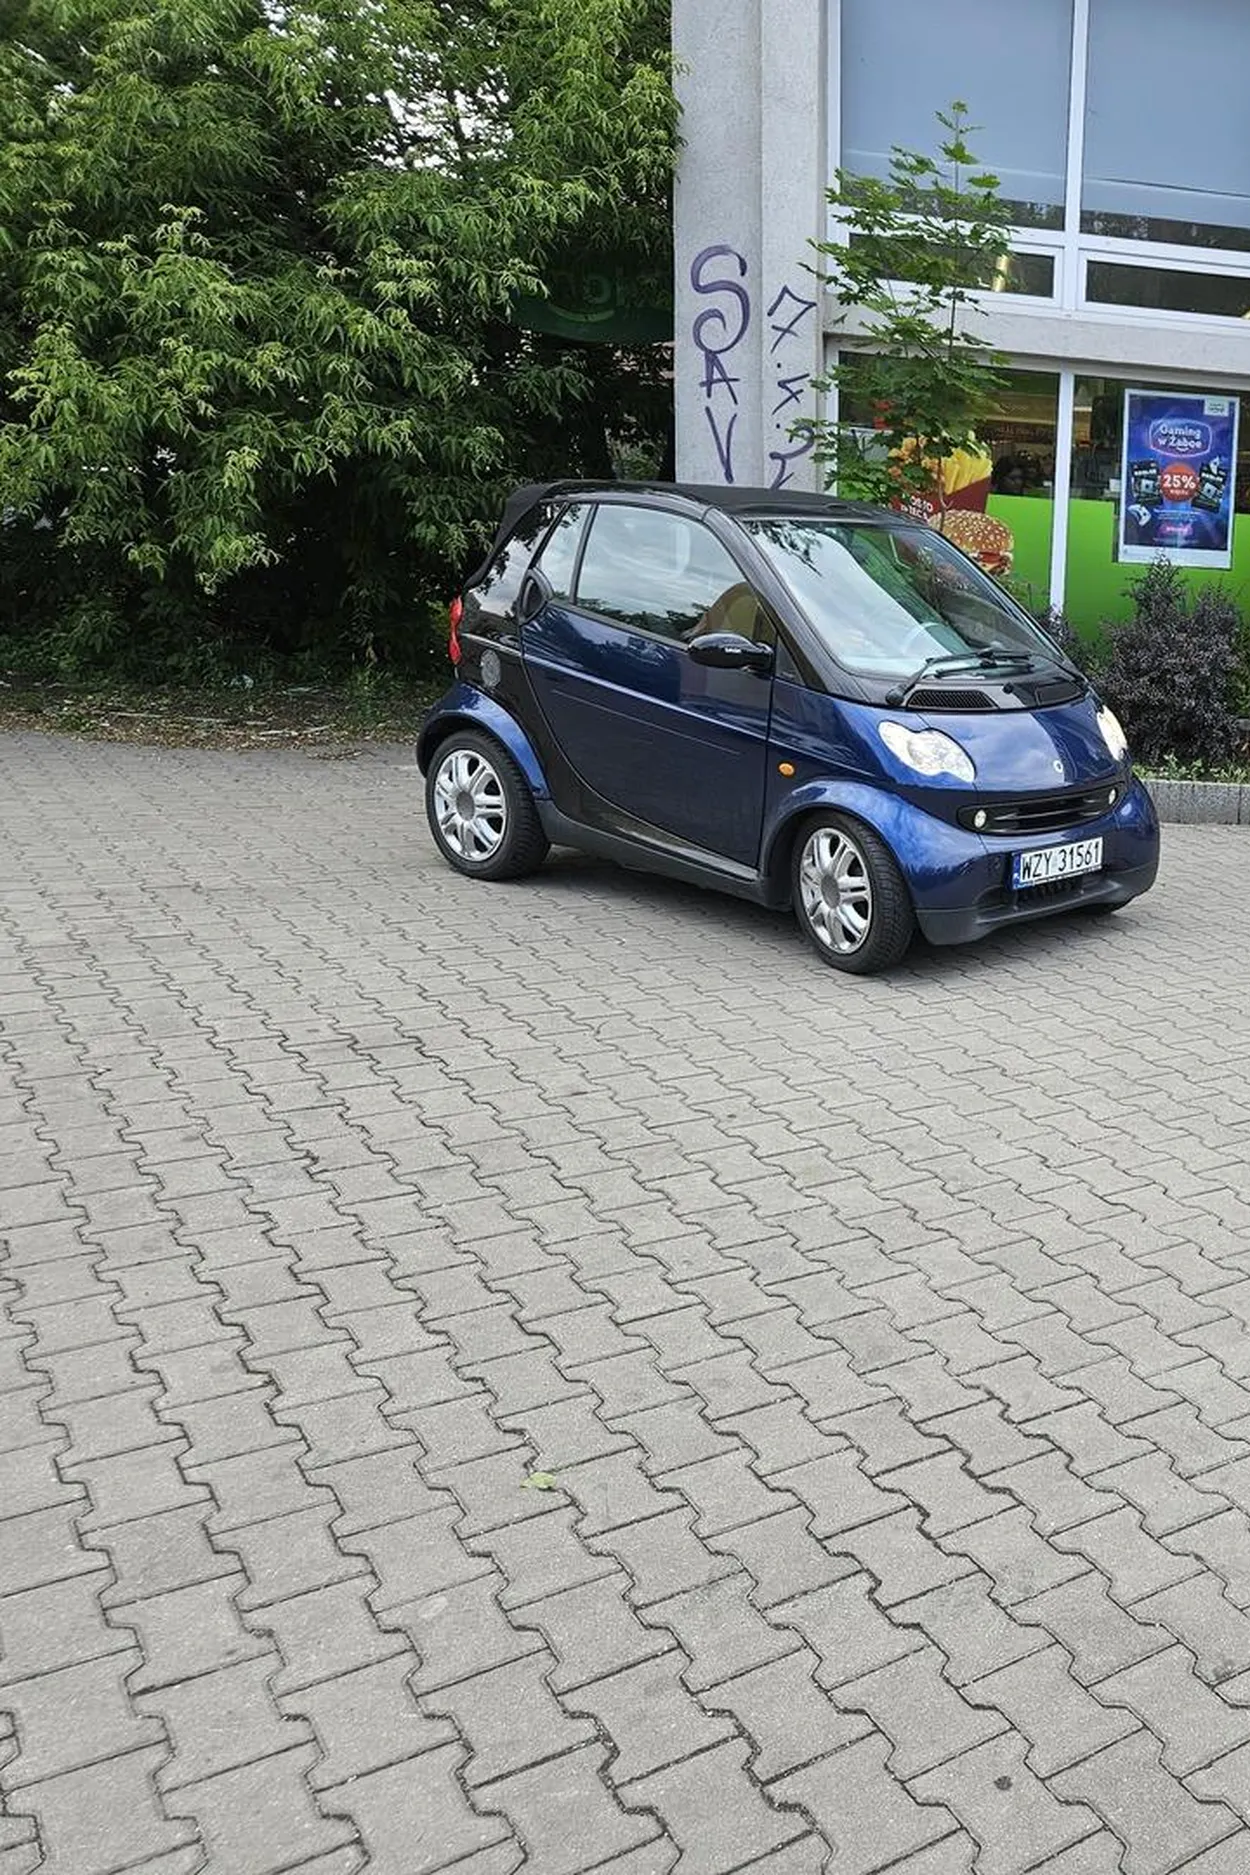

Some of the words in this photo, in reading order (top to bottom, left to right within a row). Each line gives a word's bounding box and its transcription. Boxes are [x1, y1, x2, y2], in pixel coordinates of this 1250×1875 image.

[1160, 423, 1202, 440] Gaming
[1163, 474, 1197, 490] 25%
[1022, 851, 1053, 880] WZY
[1058, 841, 1100, 872] 31561
